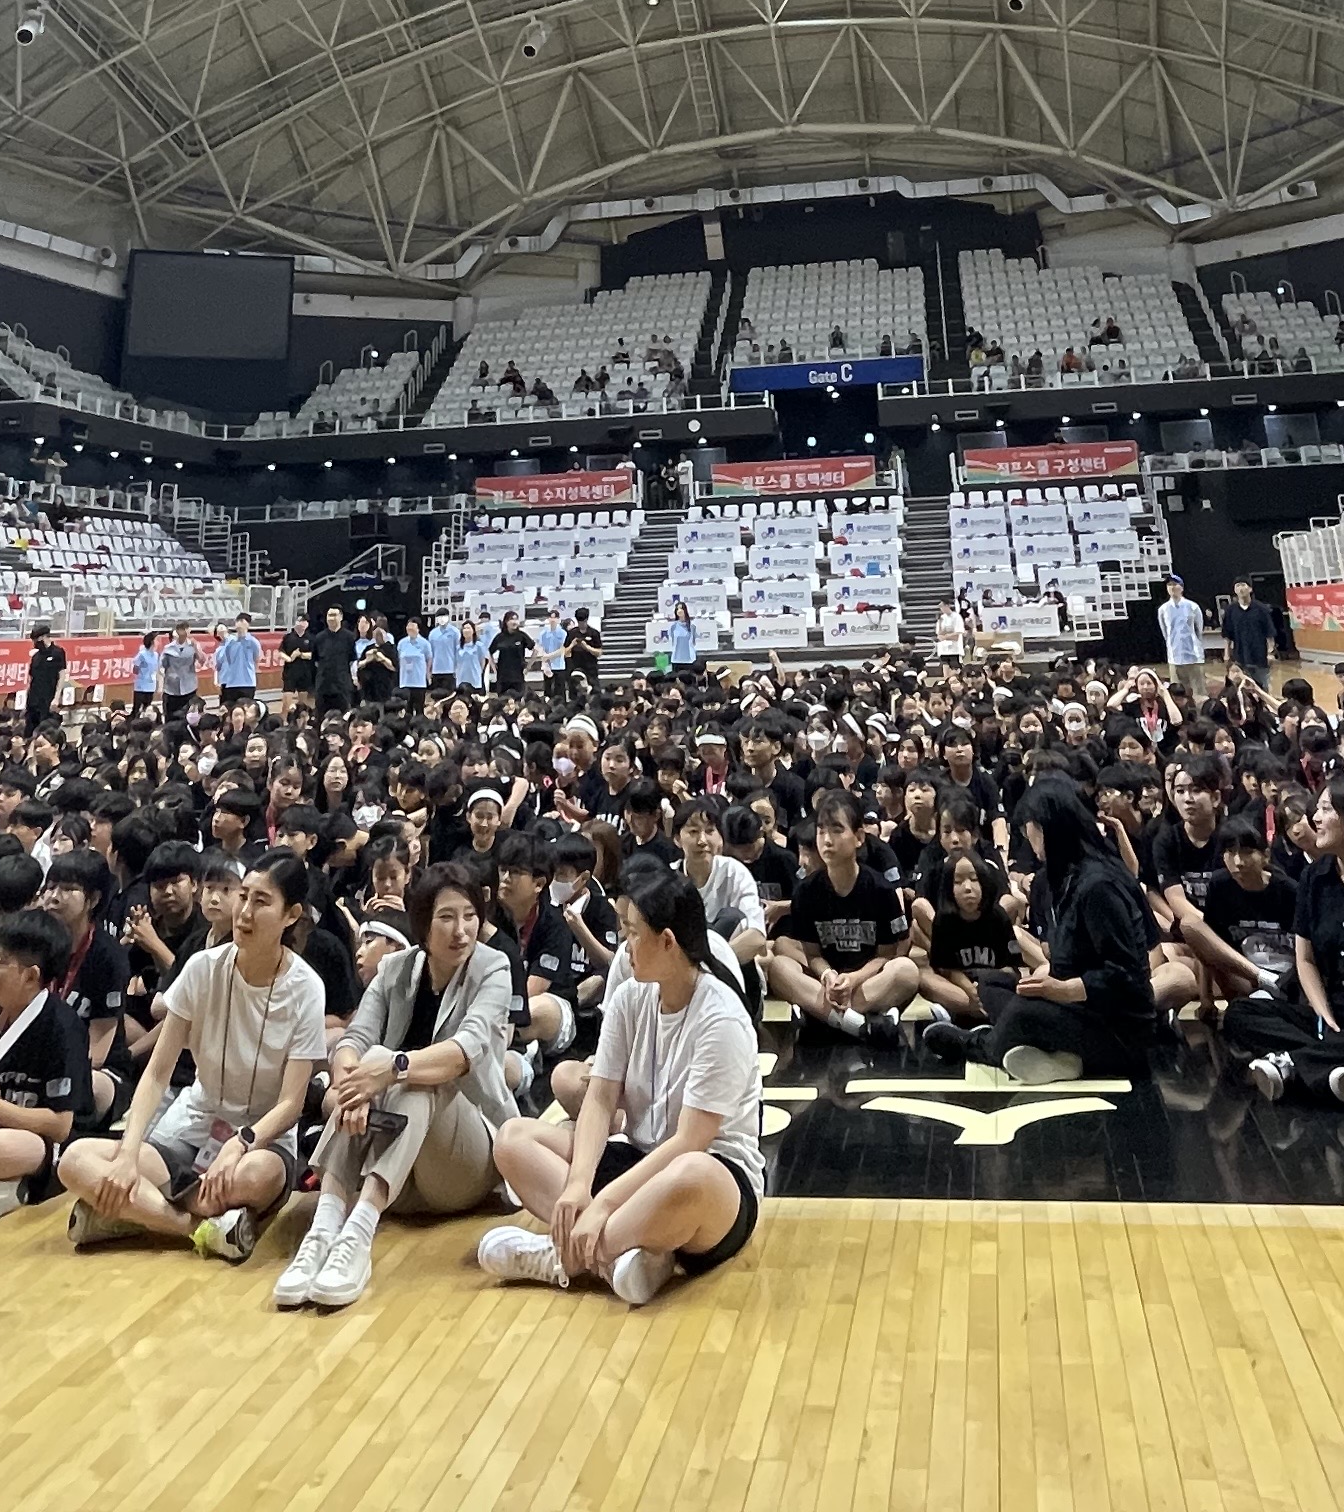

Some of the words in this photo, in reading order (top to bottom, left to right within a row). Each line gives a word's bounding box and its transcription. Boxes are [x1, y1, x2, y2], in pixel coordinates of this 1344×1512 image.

[808, 370, 838, 384] Gate
[841, 363, 853, 382] C
[996, 458, 1049, 476] 점프스쿨
[1053, 456, 1107, 475] 구성센터
[742, 473, 792, 490] 점프스쿨
